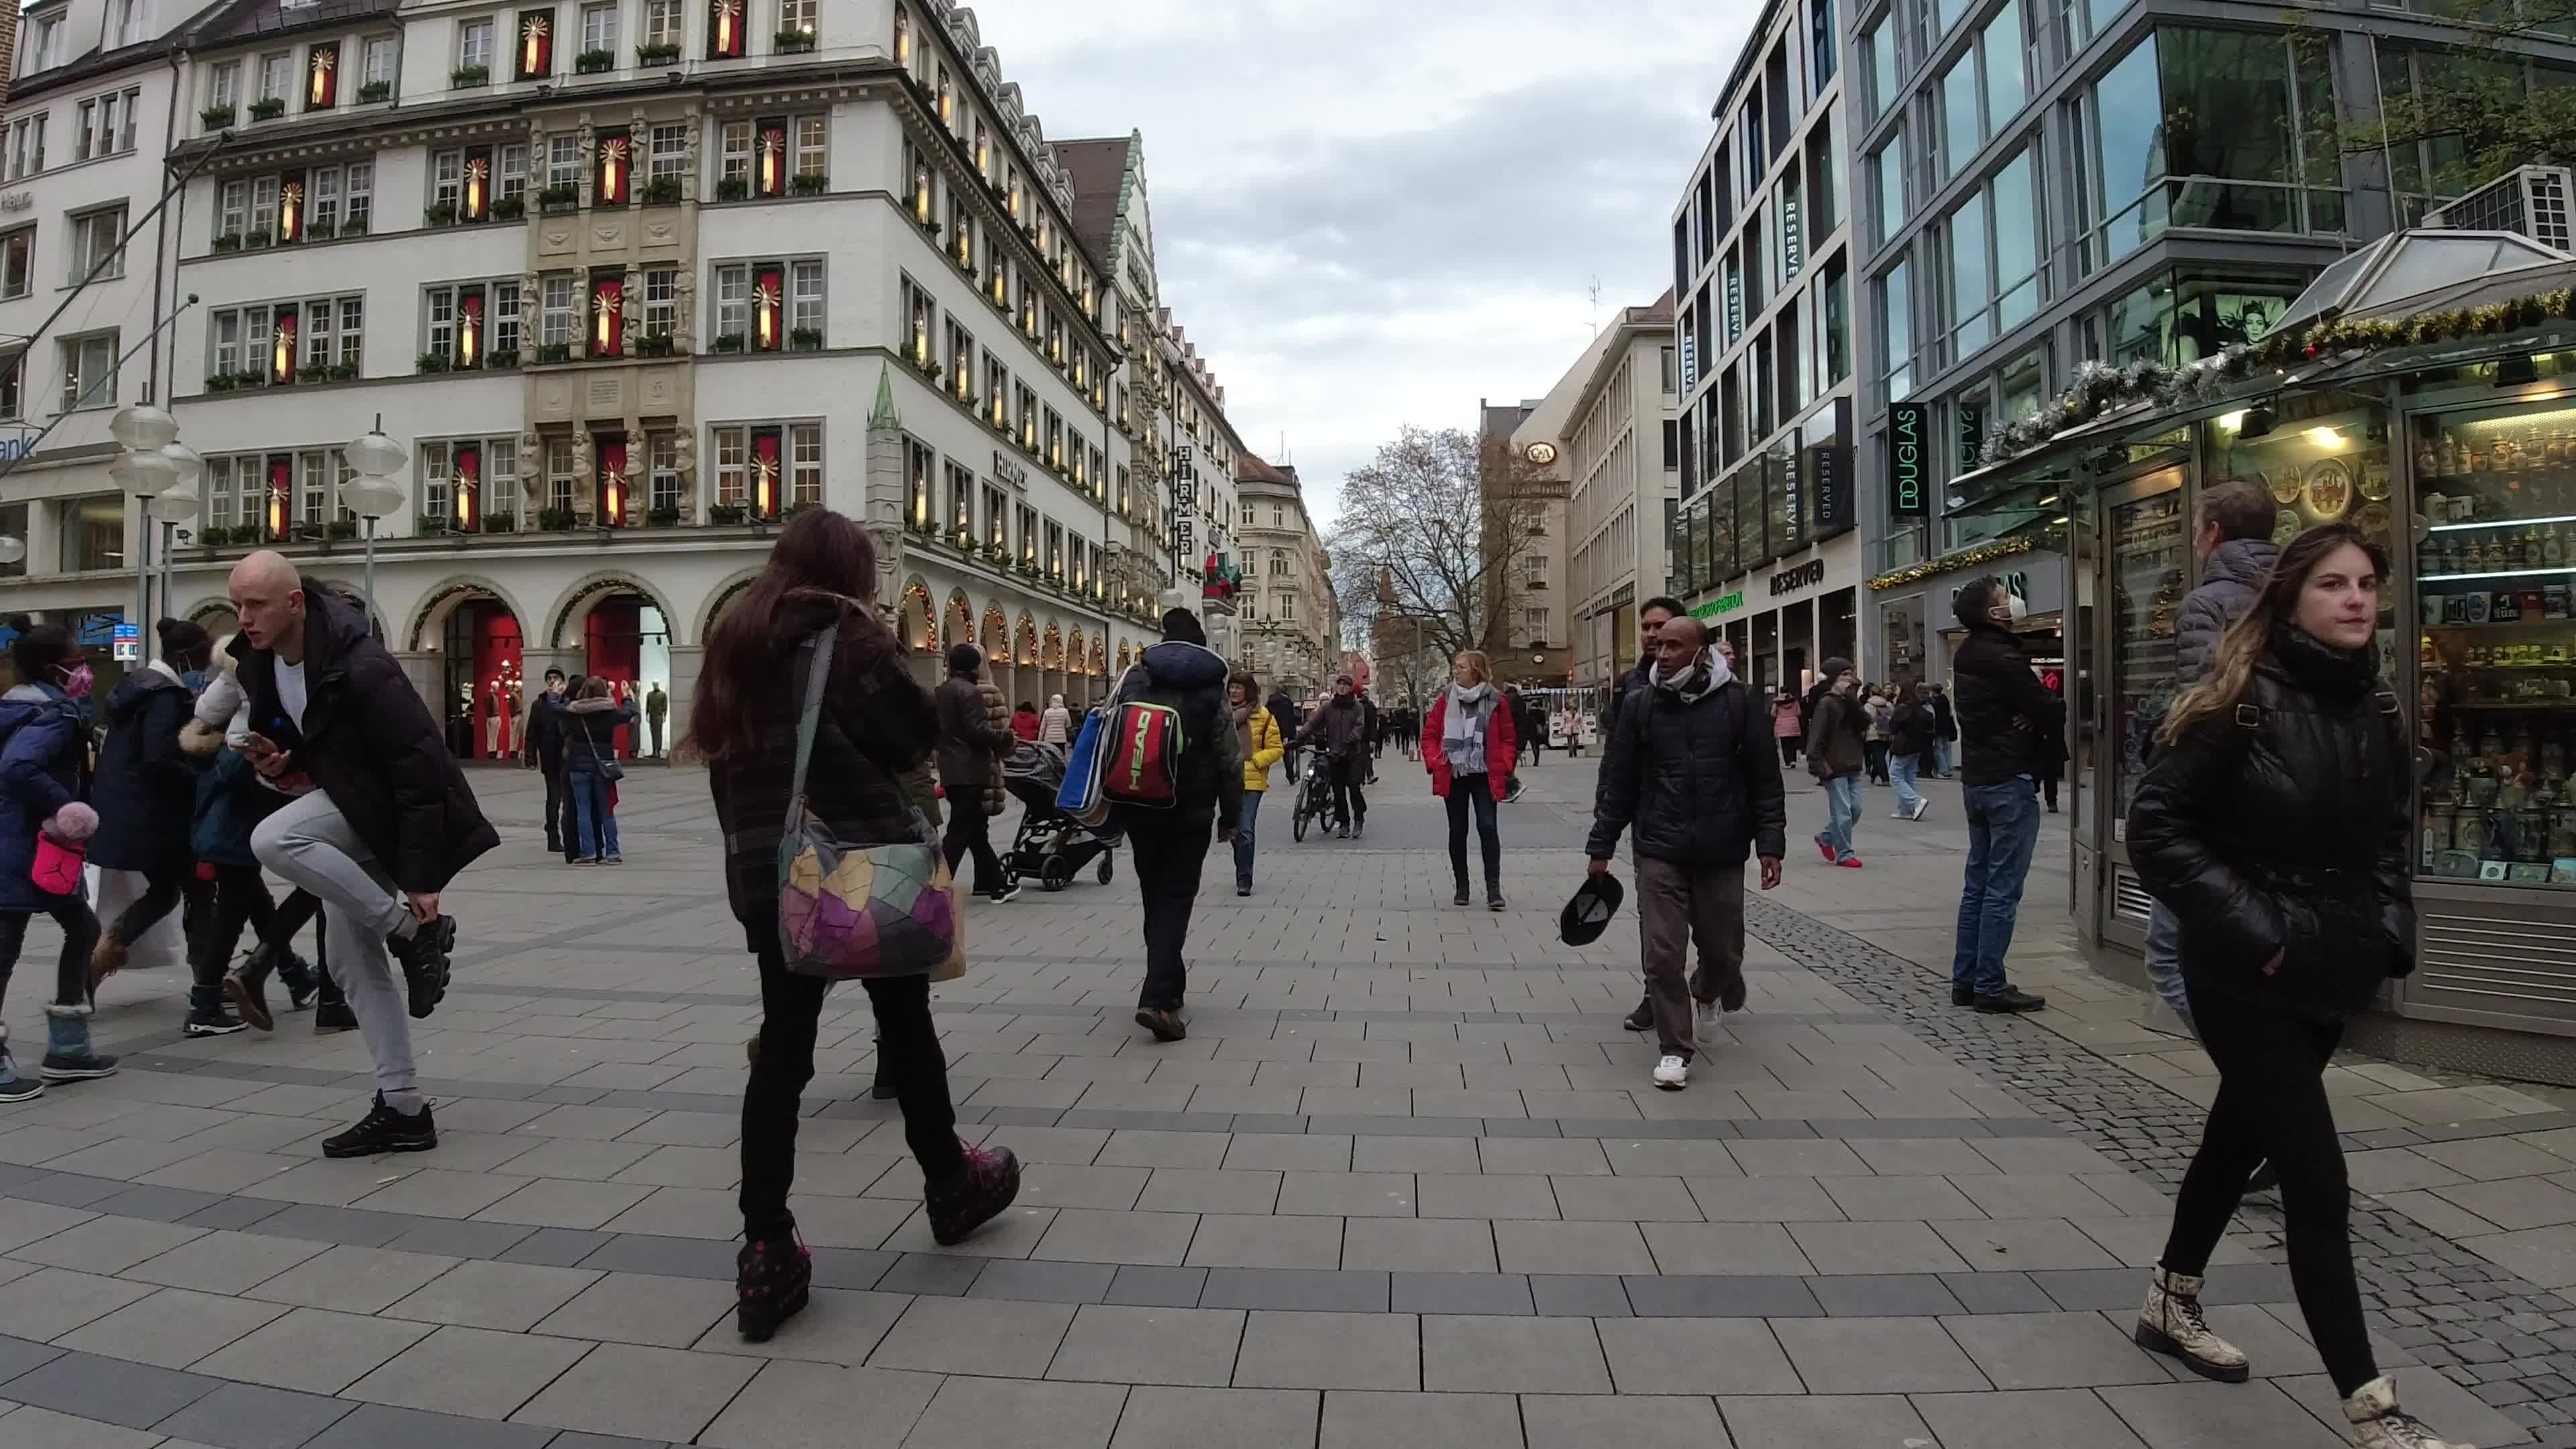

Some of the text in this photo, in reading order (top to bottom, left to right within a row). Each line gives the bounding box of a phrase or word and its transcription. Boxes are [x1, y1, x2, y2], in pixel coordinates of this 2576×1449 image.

[1786, 203, 1799, 282] RESERVE
[1729, 278, 1739, 344] RESERVE
[1685, 336, 1694, 397] RESERVE
[1821, 452, 1831, 519] RESERVED
[1898, 410, 1919, 508] DOUGLAS
[1178, 447, 1191, 554] HIRMER
[1130, 711, 1152, 790] HEAD
